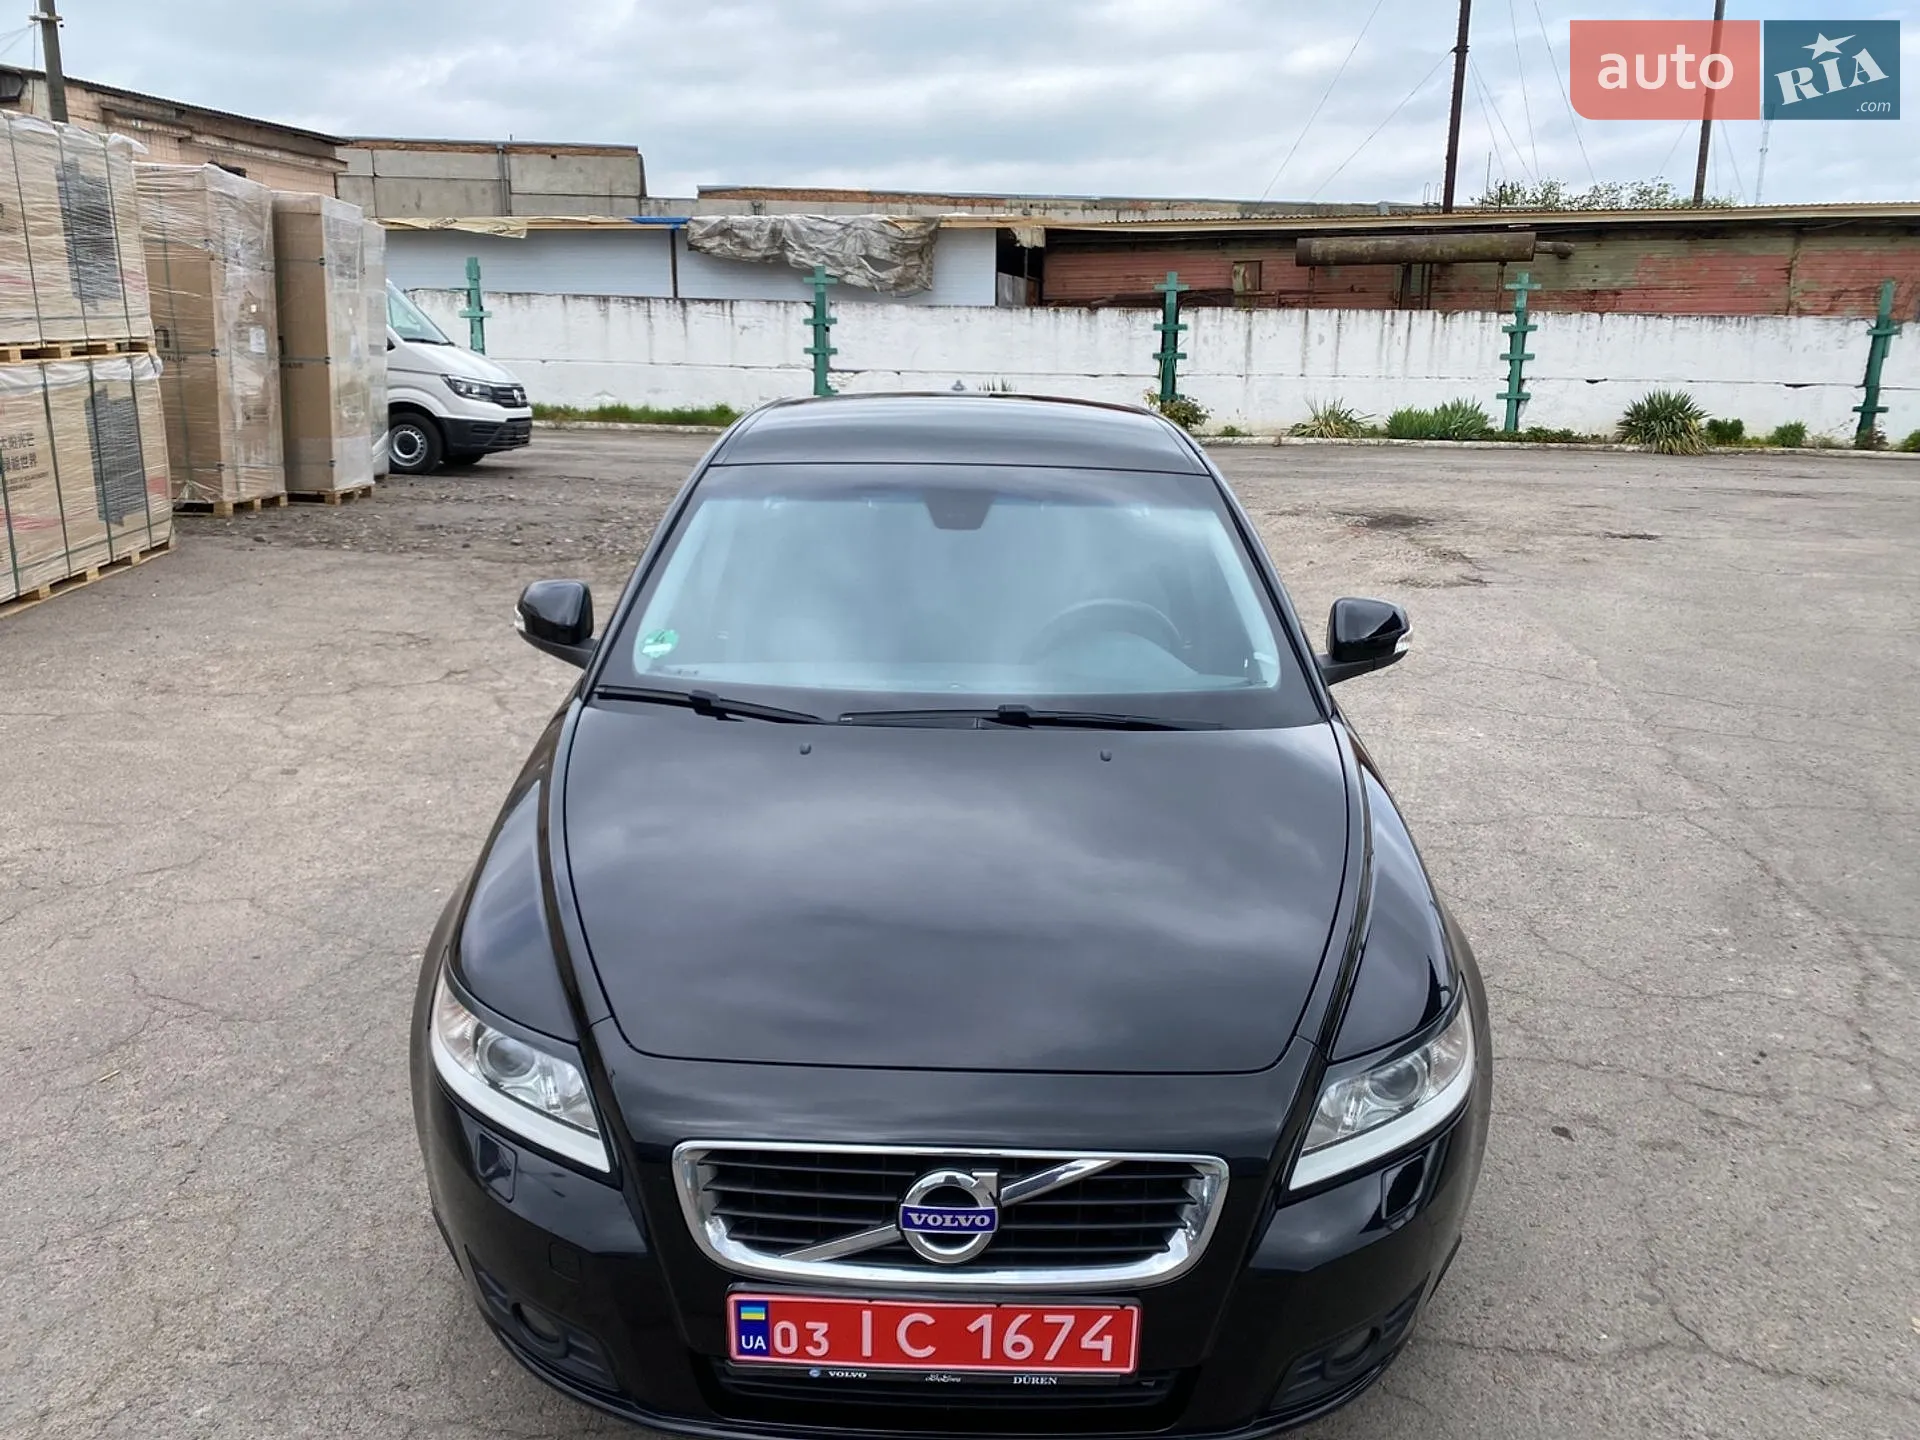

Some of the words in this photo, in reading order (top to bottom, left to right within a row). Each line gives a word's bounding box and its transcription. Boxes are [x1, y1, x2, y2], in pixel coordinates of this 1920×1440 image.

[907, 1212, 991, 1227] VOLVO
[741, 1334, 767, 1351] UA
[773, 1320, 830, 1358] 03
[966, 1313, 1114, 1362] 1674
[828, 1371, 867, 1379] VOLVO
[1013, 1375, 1058, 1385] DÜREN
